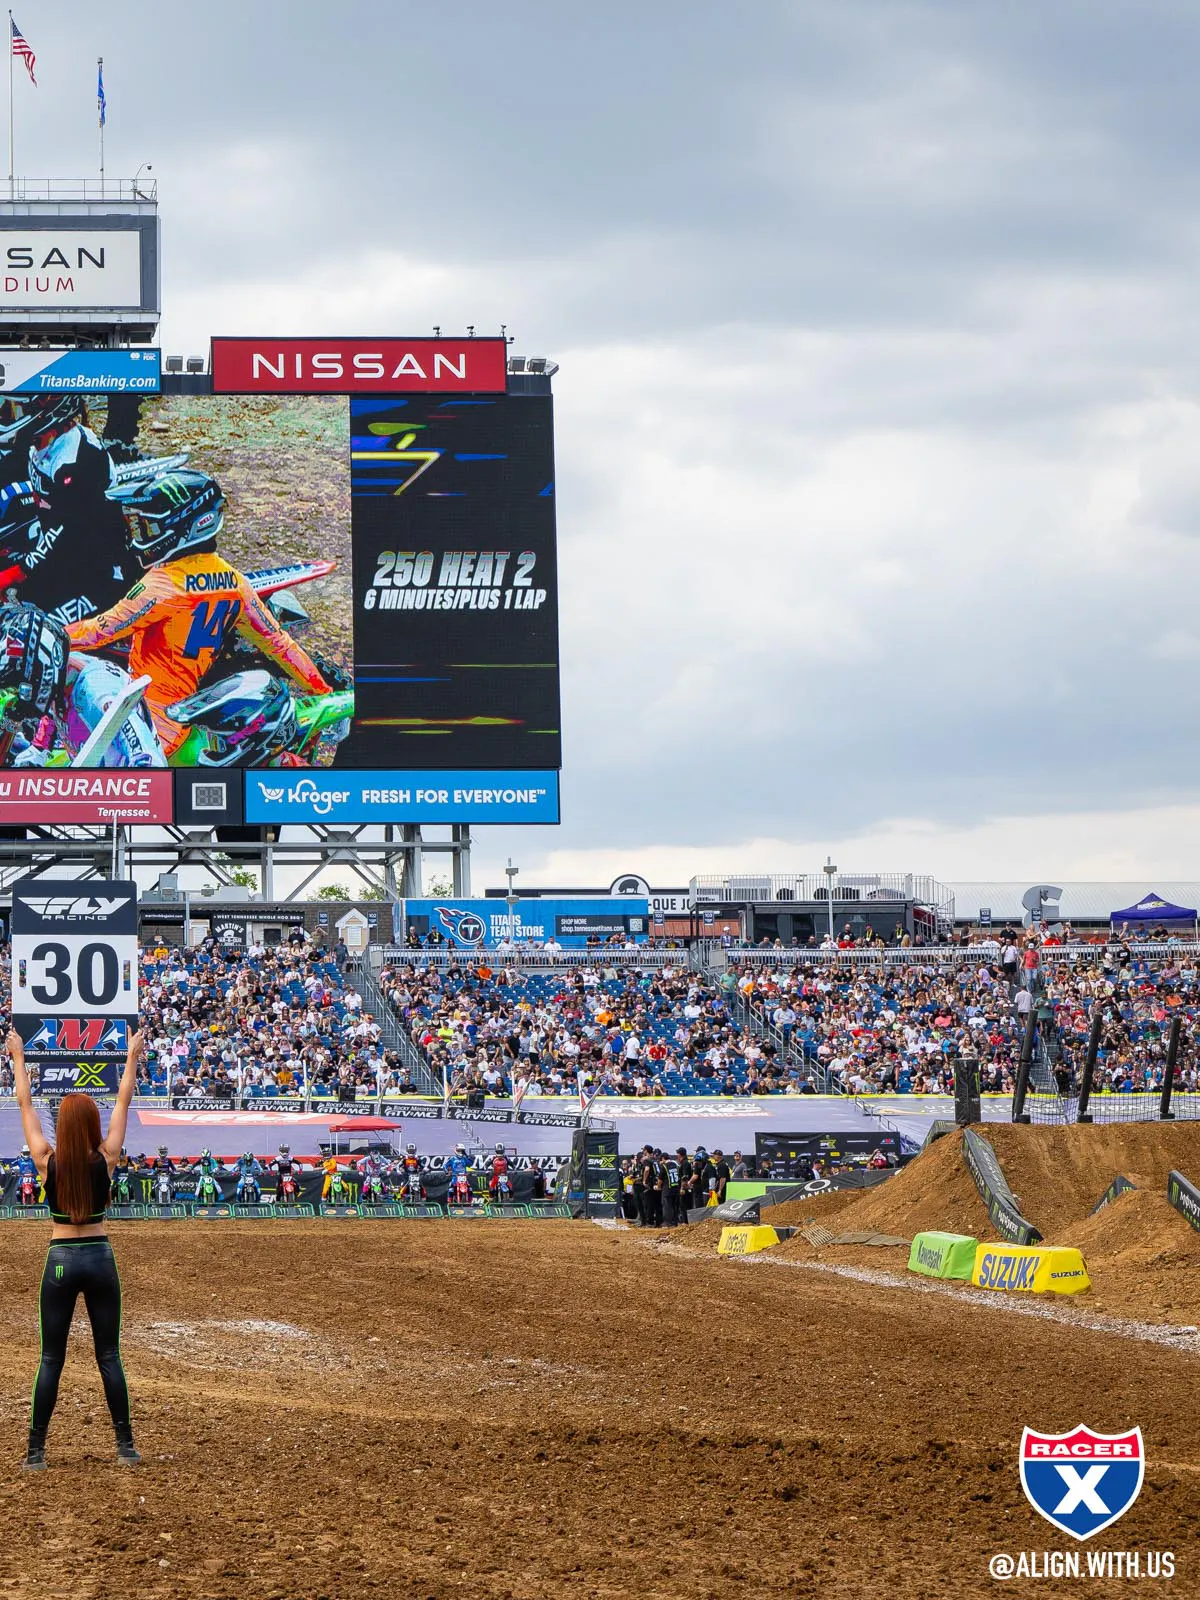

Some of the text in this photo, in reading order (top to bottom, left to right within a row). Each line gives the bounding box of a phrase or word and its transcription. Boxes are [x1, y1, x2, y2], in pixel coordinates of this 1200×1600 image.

[252, 353, 467, 379] NISSAN
[40, 374, 156, 391] TitansBanking.com
[373, 551, 537, 587] 250 HEAT 2
[364, 589, 547, 610] 6 MINUTES/PLUS 1 LAP
[47, 595, 98, 627] NEAL
[18, 778, 152, 797] INSURANCE
[288, 779, 350, 815] Kroger
[362, 790, 412, 804] FRESH
[416, 790, 449, 804] FOR
[98, 807, 150, 818] Tennessee
[19, 897, 131, 915] FLY
[215, 922, 245, 932] MARTIN'S
[490, 926, 544, 936] TEAM STORE
[31, 942, 119, 1006] 30
[23, 1019, 128, 1050] AMA
[42, 1062, 108, 1086] SMX
[471, 1154, 572, 1170] MUNTAI
[588, 1157, 616, 1168] SMX
[670, 1172, 679, 1183] 15
[589, 1191, 616, 1202] SMX
[1180, 1191, 1200, 1217] MONST
[917, 1241, 943, 1271] Kawasaki
[978, 1254, 1040, 1290] SUZUKI
[1050, 1270, 1084, 1278] SUZUKI
